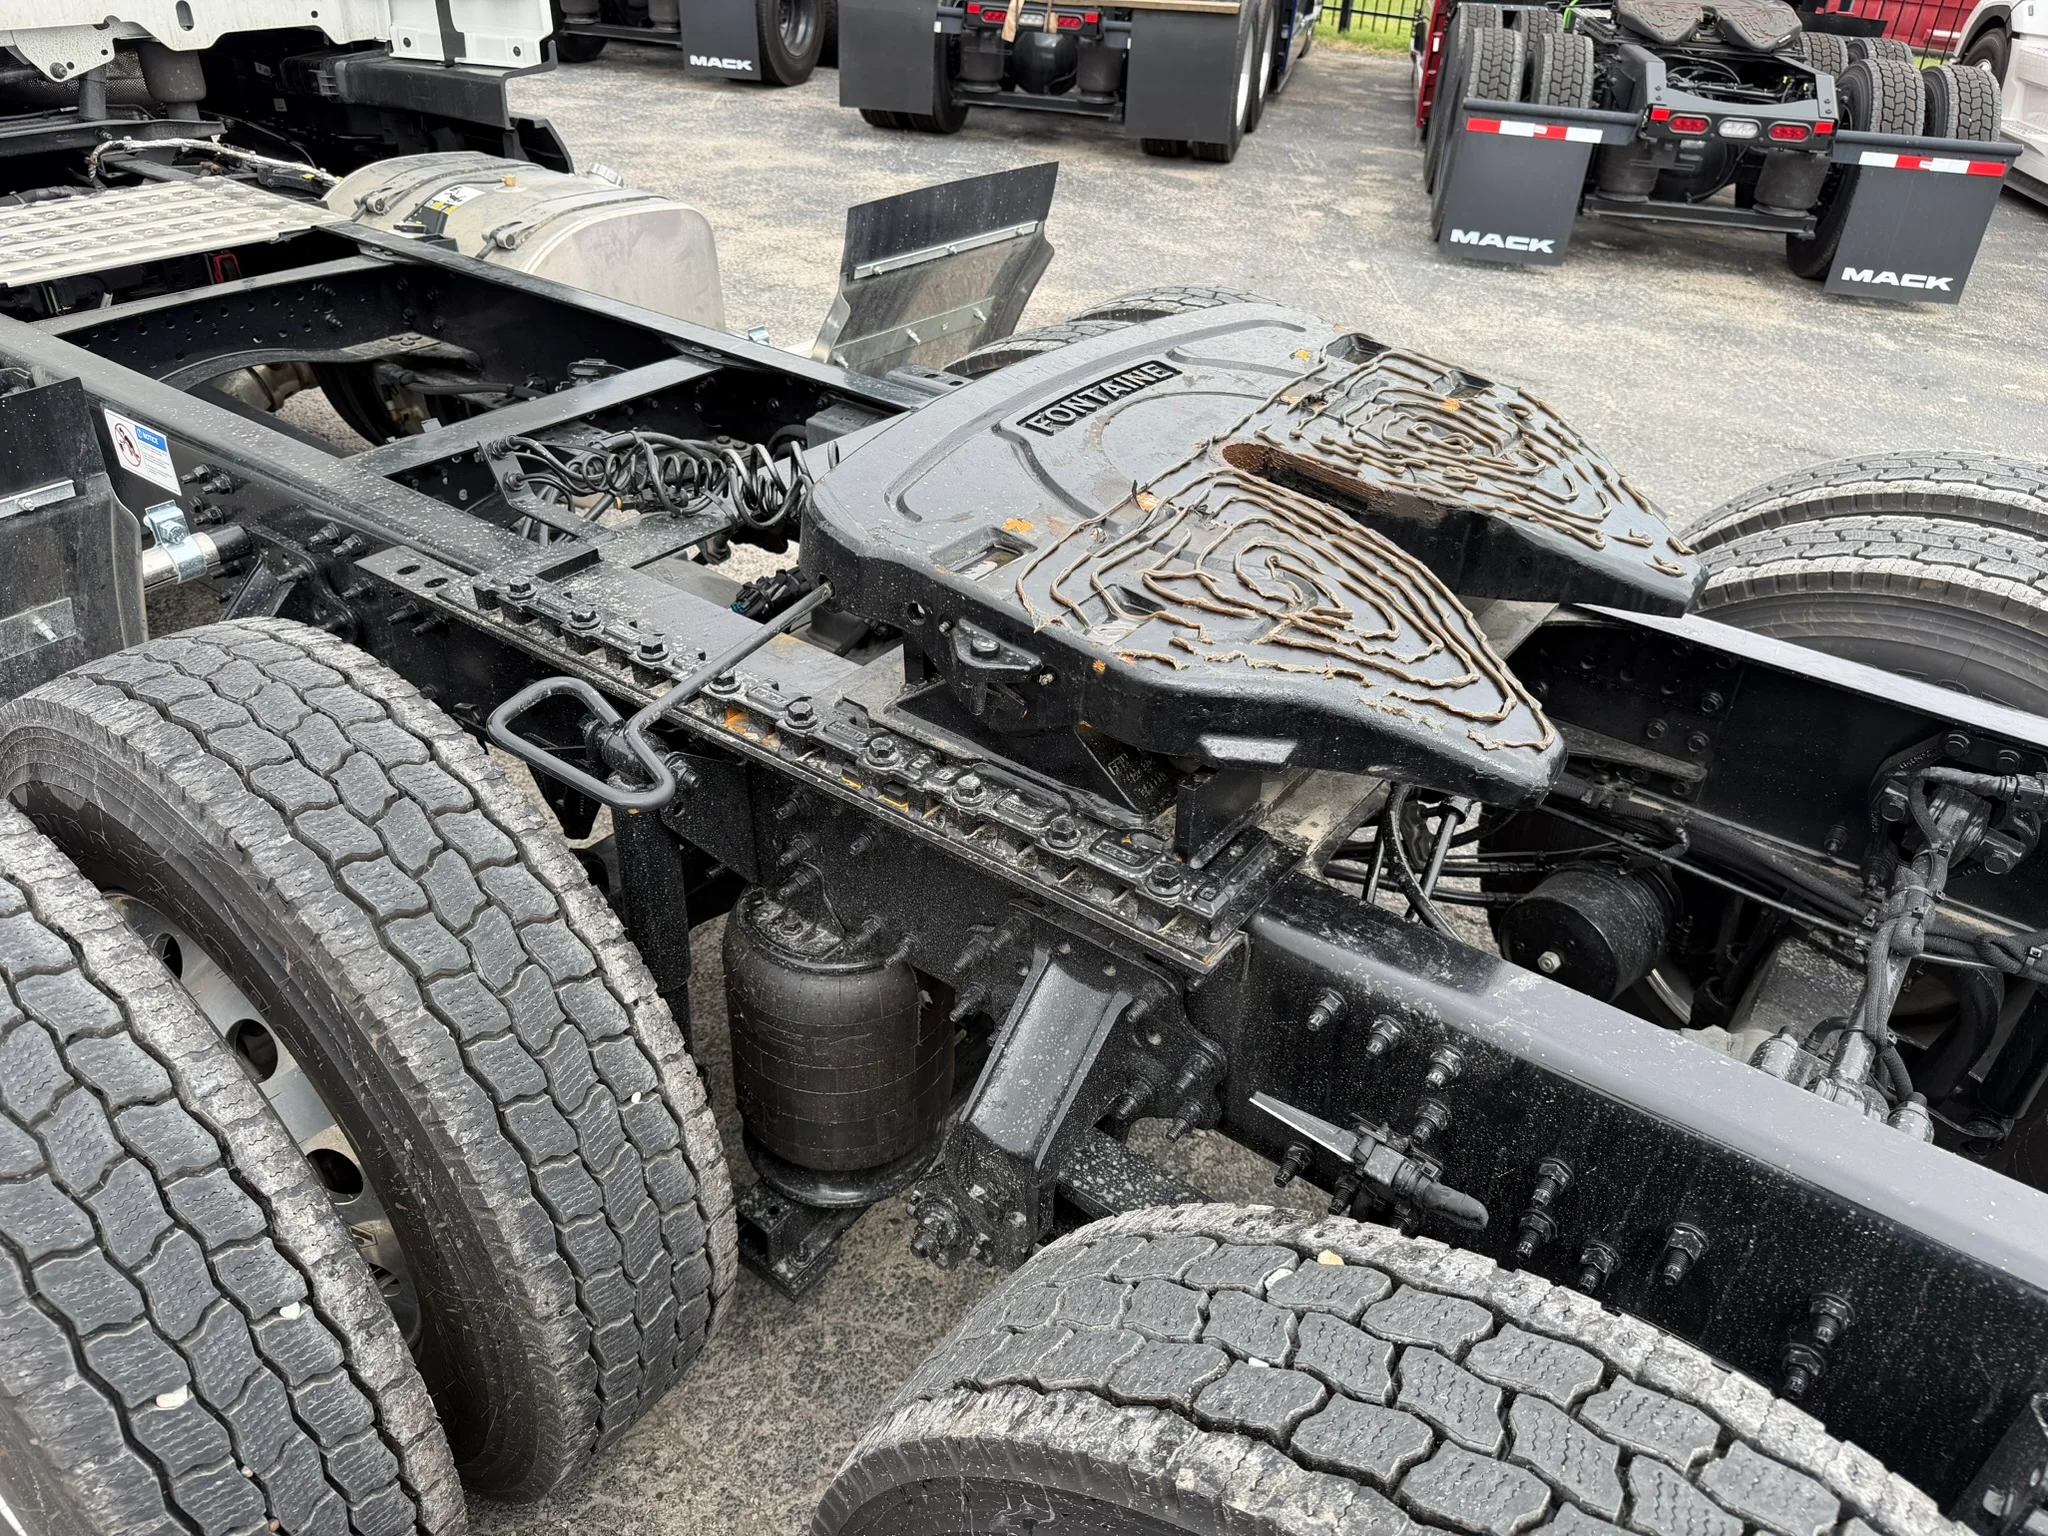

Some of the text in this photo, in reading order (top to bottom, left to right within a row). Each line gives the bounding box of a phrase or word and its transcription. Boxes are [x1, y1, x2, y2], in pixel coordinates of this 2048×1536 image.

[690, 55, 753, 71] MACK
[1450, 228, 1555, 253] MACK
[1841, 266, 1954, 291] MACK
[1025, 364, 1175, 436] FONTAINE
[143, 432, 159, 445] NOTICE
